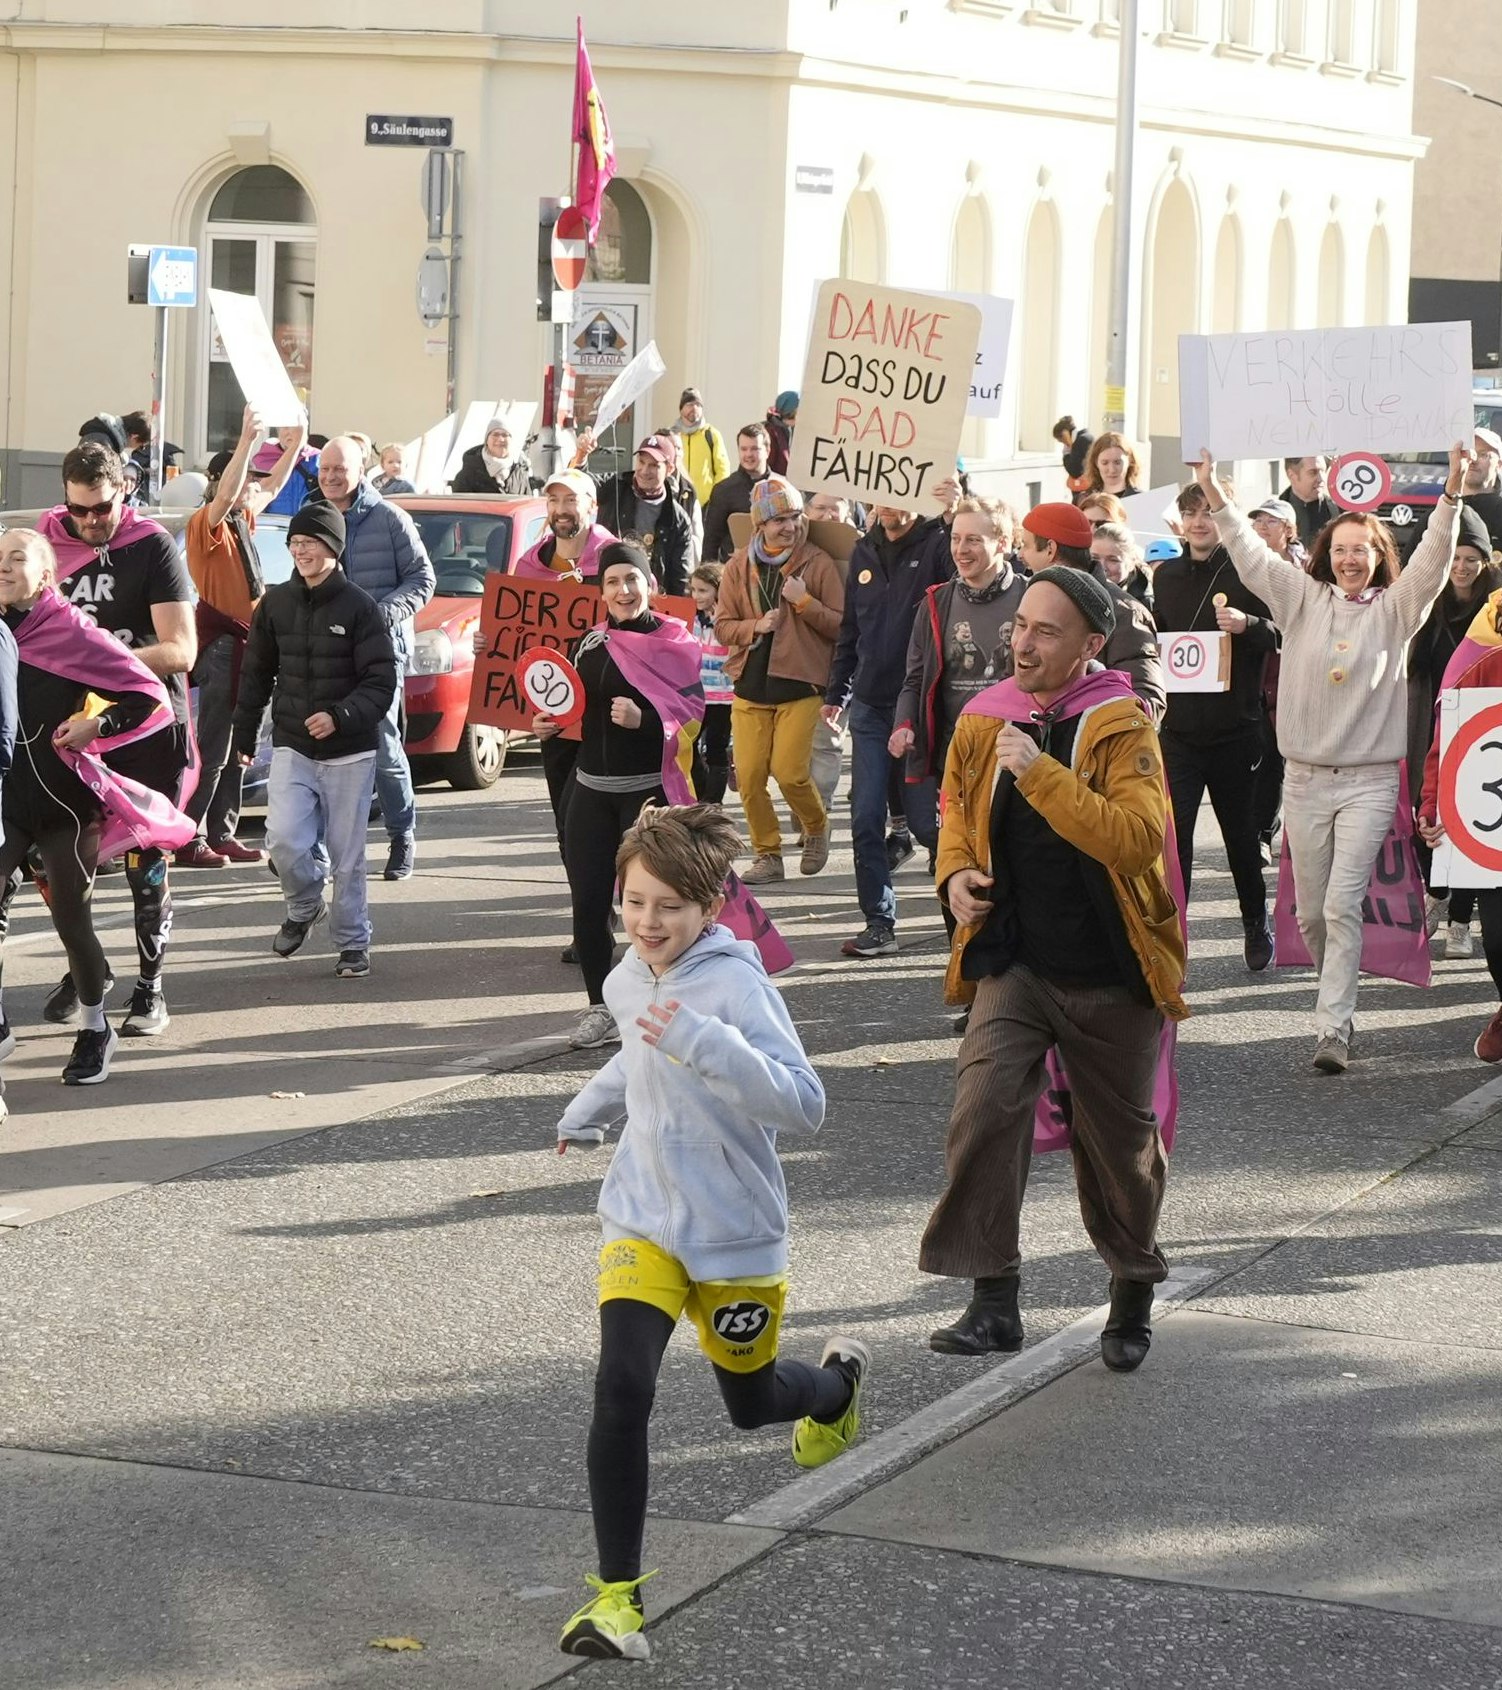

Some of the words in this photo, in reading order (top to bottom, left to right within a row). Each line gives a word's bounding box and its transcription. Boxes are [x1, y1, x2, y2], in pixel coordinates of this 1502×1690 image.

[383, 122, 447, 138] Säulengasse
[828, 293, 950, 361] DANKE
[580, 354, 623, 365] BETANIA
[1209, 328, 1458, 389] VERKEHRS
[904, 366, 946, 404] DU
[832, 398, 915, 449] RAD
[1247, 418, 1323, 446] NEIN
[1366, 407, 1466, 440] DANKE
[810, 437, 933, 498] FÄHRST
[1341, 464, 1376, 501] 30
[495, 586, 560, 628] DER
[1174, 644, 1200, 668] 30
[531, 664, 570, 707] 30
